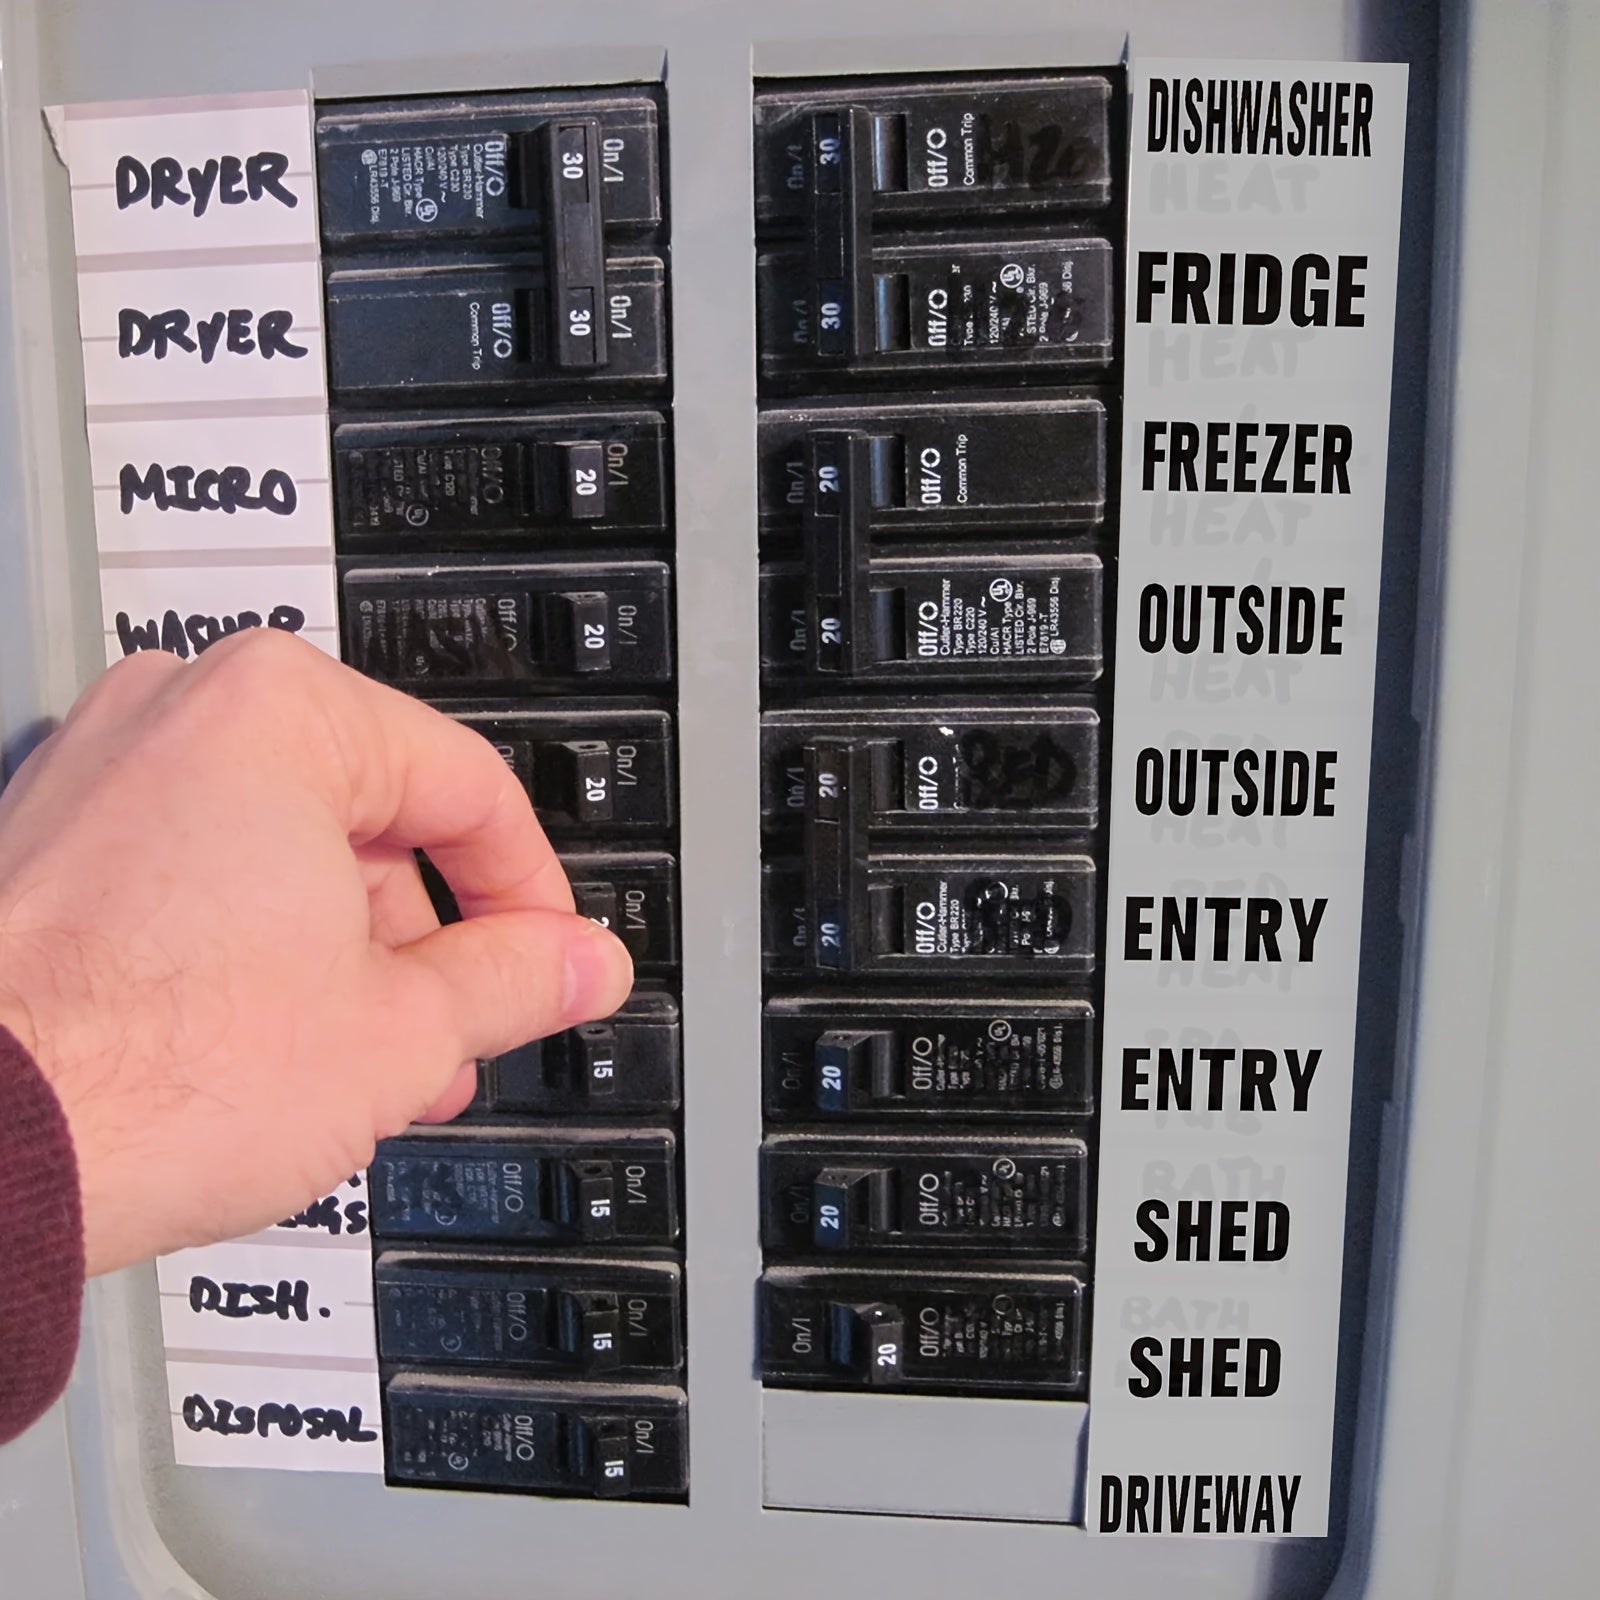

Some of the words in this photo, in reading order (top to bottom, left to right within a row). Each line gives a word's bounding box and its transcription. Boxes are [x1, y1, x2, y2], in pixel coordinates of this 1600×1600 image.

[961, 112, 974, 136] Trip
[1146, 77, 1374, 157] DISHWASHER
[819, 138, 840, 165] 30
[963, 139, 975, 186] Common
[562, 153, 583, 180] 30
[115, 152, 298, 217] DRYER
[1136, 251, 1368, 328] FRIDGE
[470, 302, 480, 346] Common
[570, 309, 590, 336] 30
[821, 302, 841, 330] 30
[118, 307, 308, 364] DRYER
[471, 348, 482, 370] Trip
[955, 434, 968, 456] Trip
[1142, 421, 1352, 494] FREEZER
[119, 463, 298, 515] MICRO
[575, 469, 597, 496] 20
[818, 466, 839, 493] 20
[956, 458, 968, 503] Common
[940, 578, 951, 656] Cutler-Hammer
[965, 606, 975, 631] C220
[1003, 601, 1014, 624] Type
[1138, 583, 1345, 656] OUTSIDE
[584, 623, 605, 650] 20
[820, 617, 841, 644] 20
[953, 633, 963, 655] Type
[965, 633, 976, 654] Type
[977, 619, 987, 654] 120/240
[1003, 626, 1012, 655] HACR
[1014, 620, 1024, 655] LISTED
[585, 777, 606, 802] 20
[818, 773, 839, 798] 20
[1135, 748, 1338, 818] OUTSIDE
[937, 881, 948, 953] Cutler-Hammer
[1123, 896, 1329, 962] ENTRY
[820, 922, 841, 948] 20
[950, 932, 961, 953] Type
[593, 1060, 613, 1079] 15
[821, 1065, 842, 1091] 20
[1121, 1047, 1322, 1112] ENTRY
[590, 1199, 611, 1218] 15
[820, 1205, 840, 1230] 20
[1133, 1199, 1290, 1262] SHED
[592, 1332, 612, 1351] 15
[876, 1343, 897, 1367] 20
[1127, 1336, 1282, 1398] SHED
[182, 1393, 379, 1443] DISPOSAL
[604, 1460, 624, 1478] 15
[1100, 1474, 1302, 1533] DRIVEWAY
